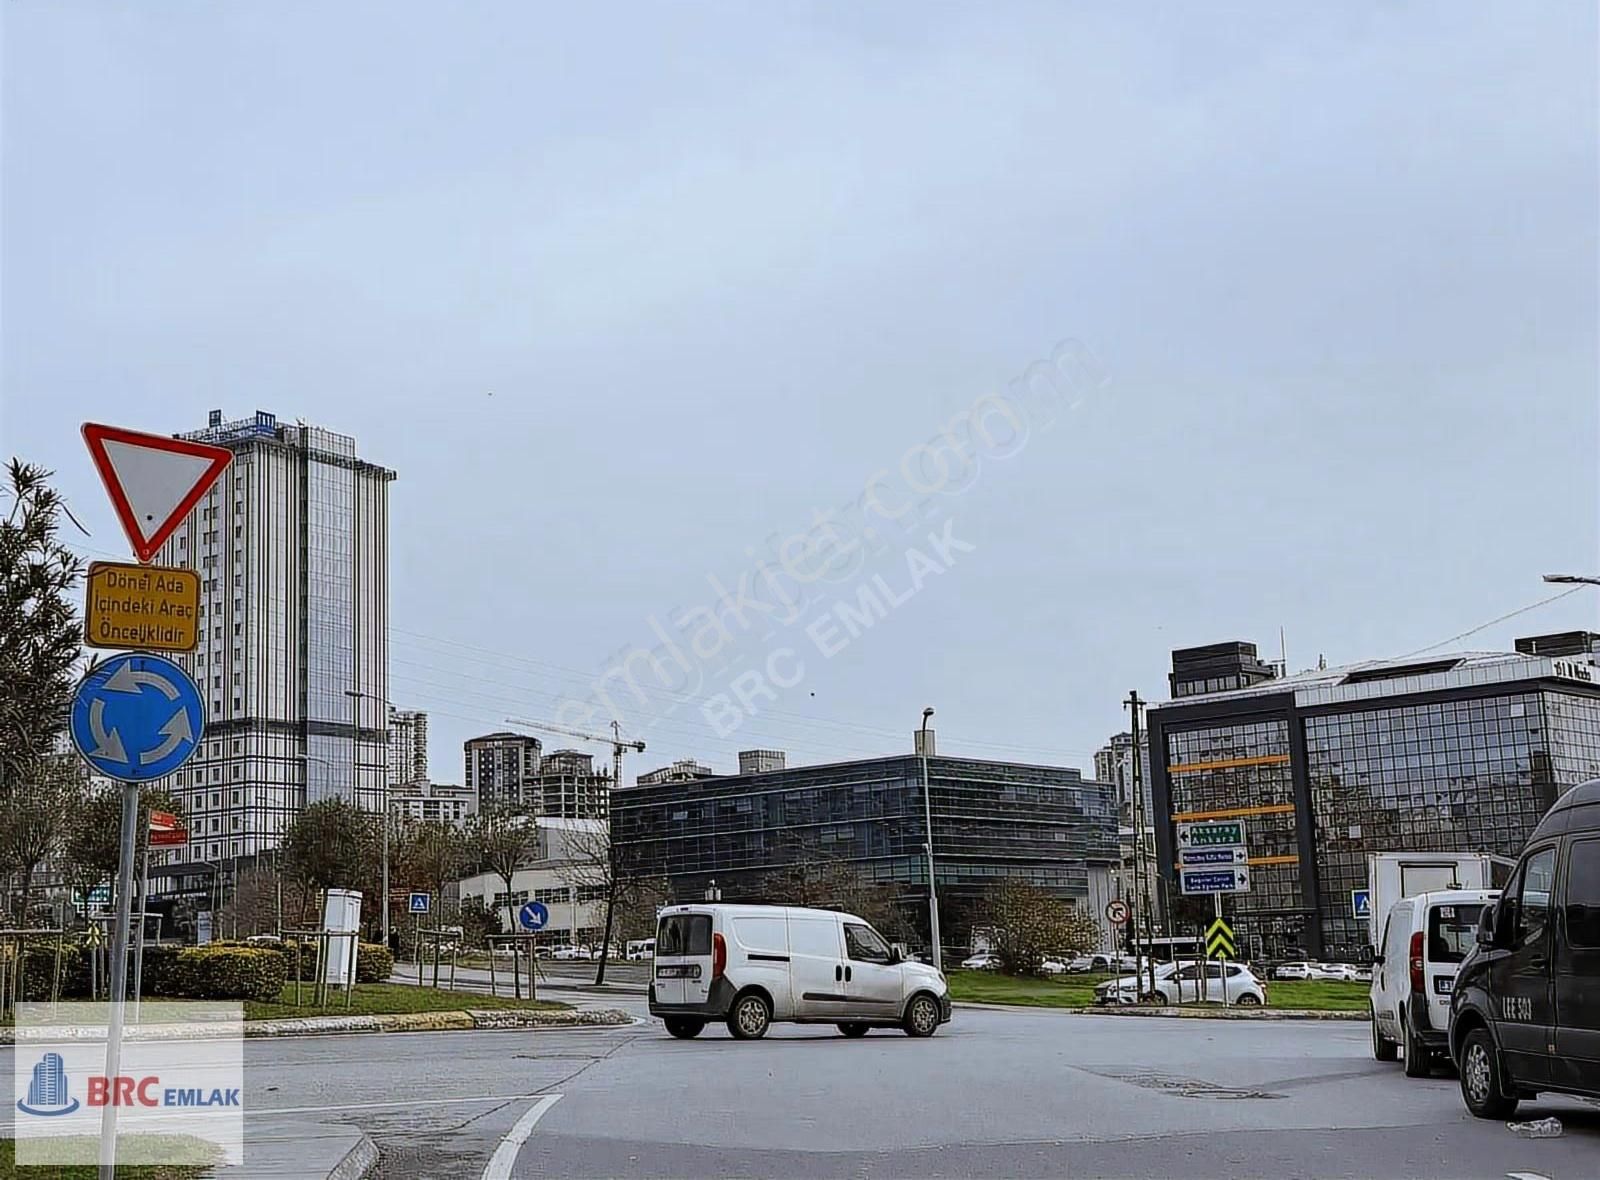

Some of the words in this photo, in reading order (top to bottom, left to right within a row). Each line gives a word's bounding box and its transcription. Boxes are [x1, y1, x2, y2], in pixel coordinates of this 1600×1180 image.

[107, 571, 151, 591] Dönel
[156, 575, 184, 593] Ada
[95, 589, 154, 615] İçindeki
[159, 599, 194, 620] Araç
